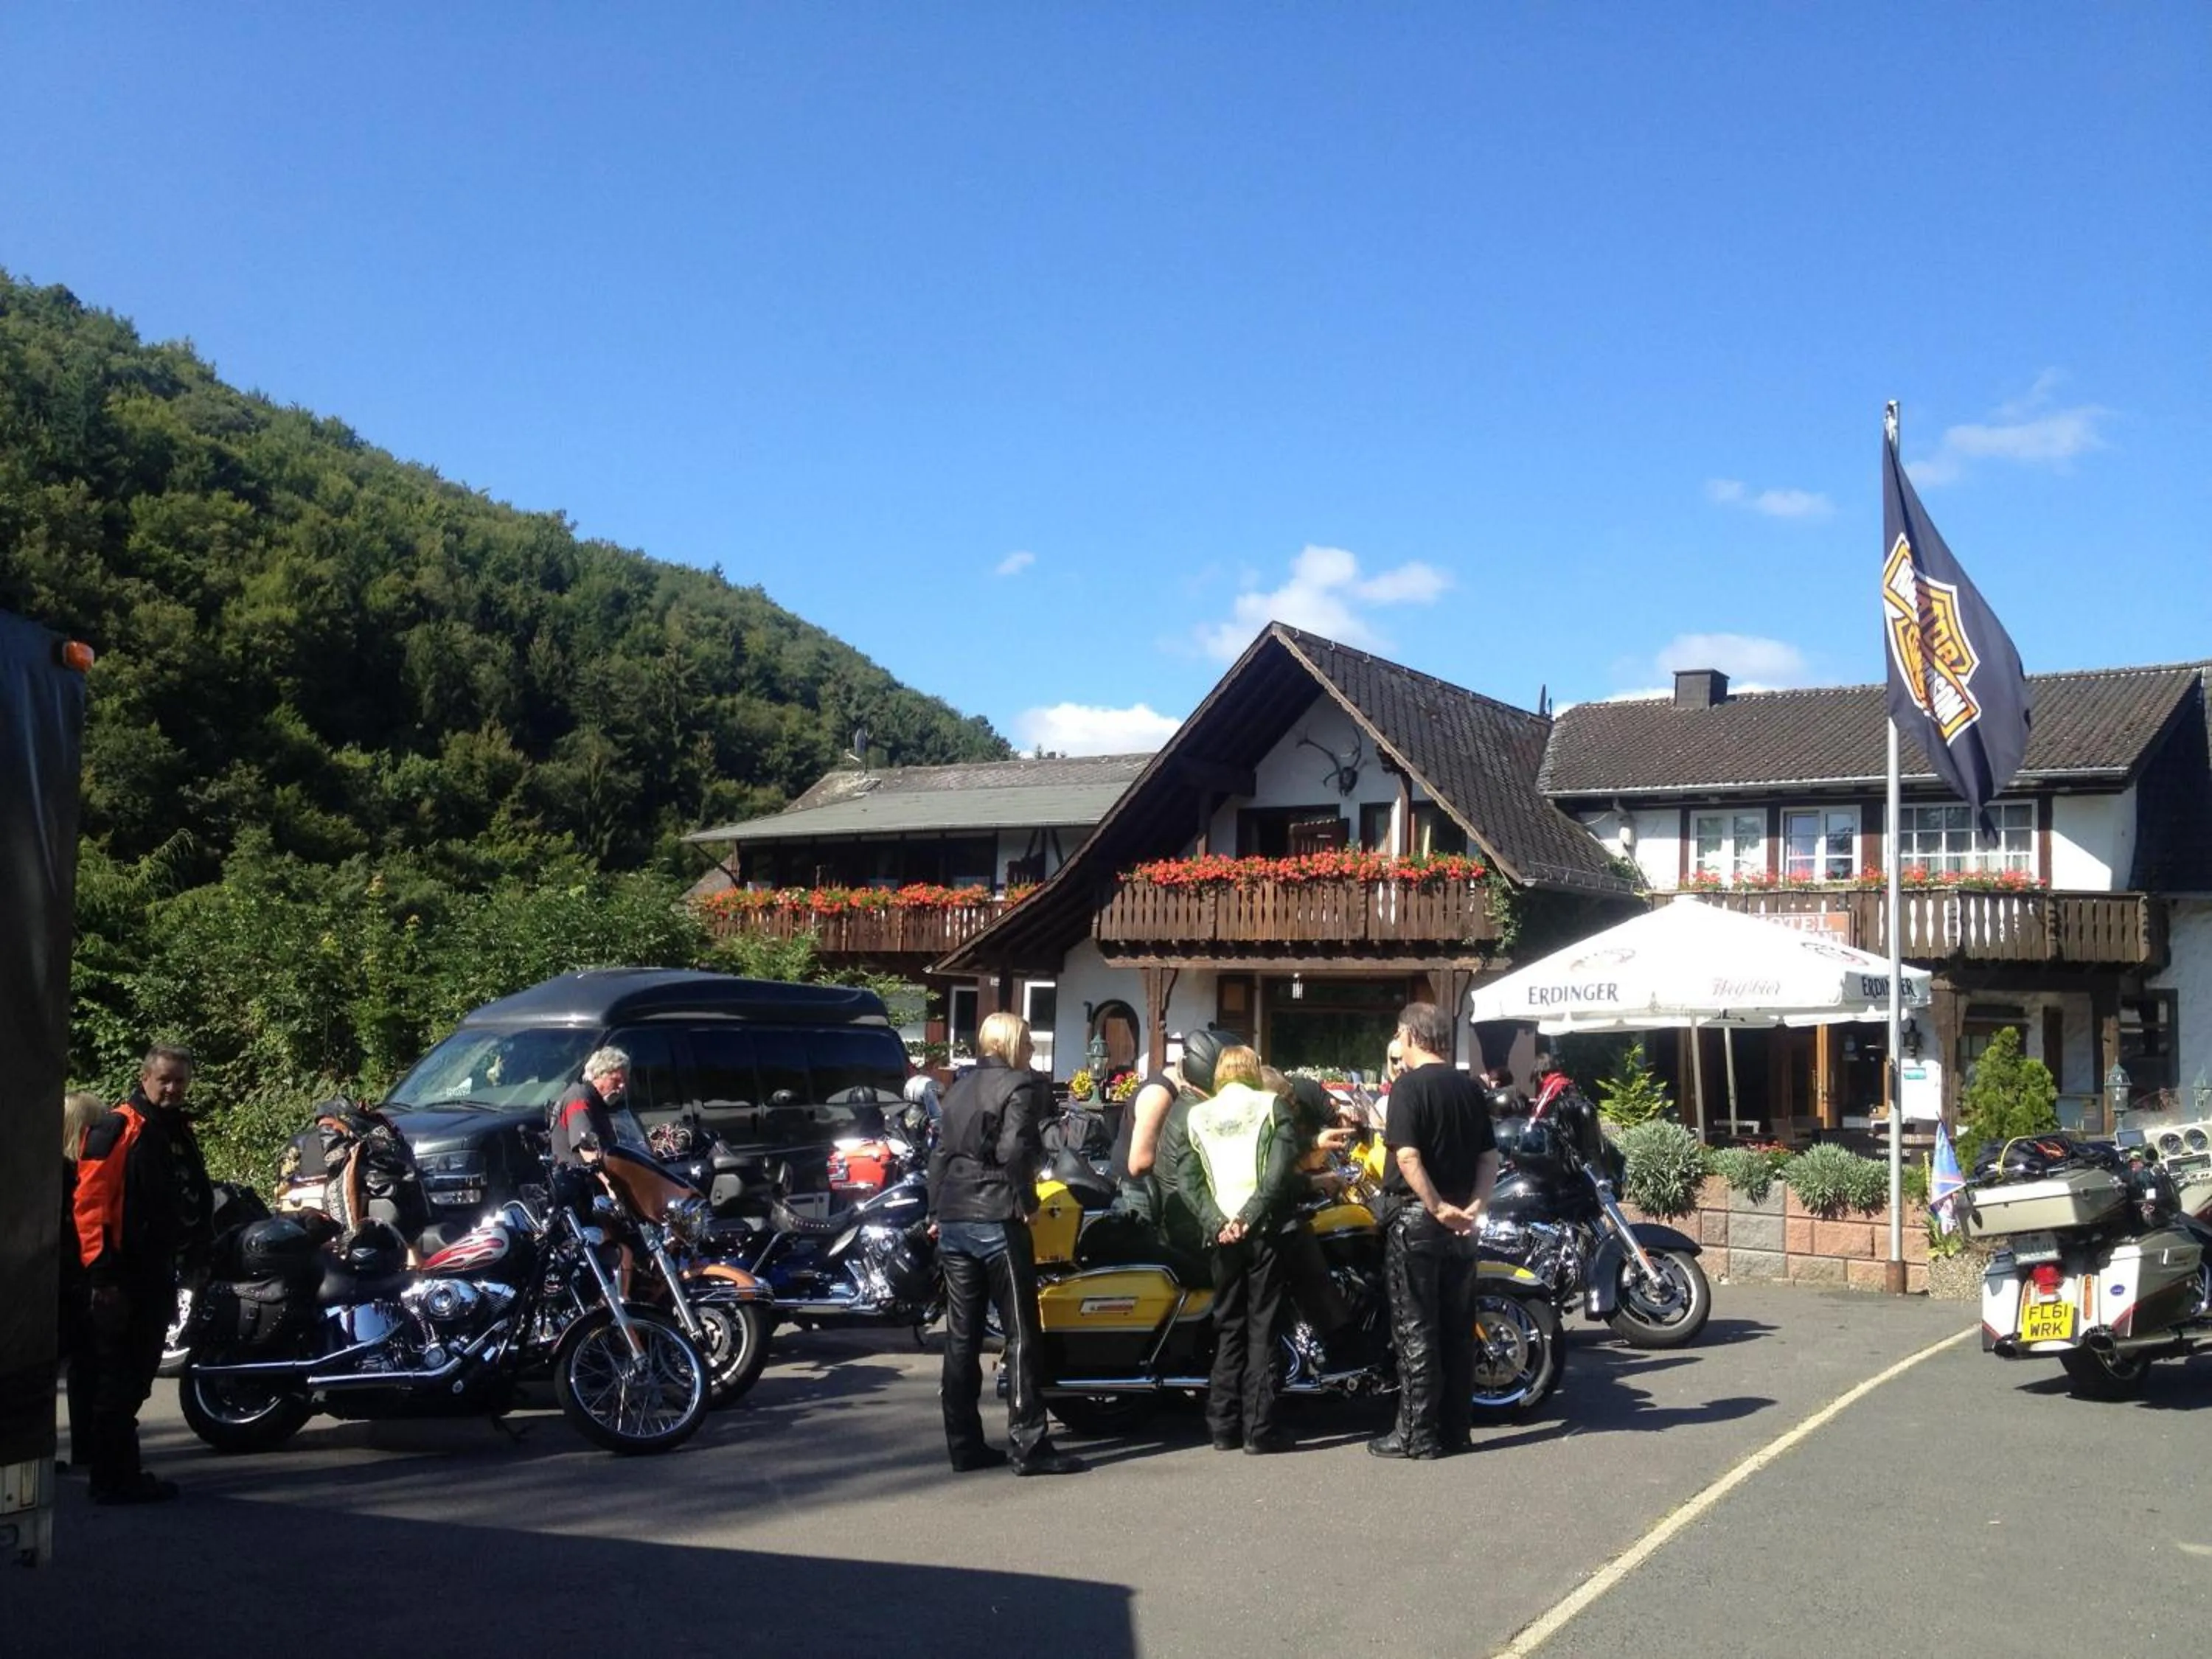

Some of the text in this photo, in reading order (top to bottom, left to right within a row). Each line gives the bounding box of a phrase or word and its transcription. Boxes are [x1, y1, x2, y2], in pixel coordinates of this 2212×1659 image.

[1528, 982, 1619, 1006] ERDINGER
[1861, 975, 1917, 998] ERDINER
[2028, 1304, 2068, 1321] FL61
[2030, 1321, 2064, 1337] WRK
